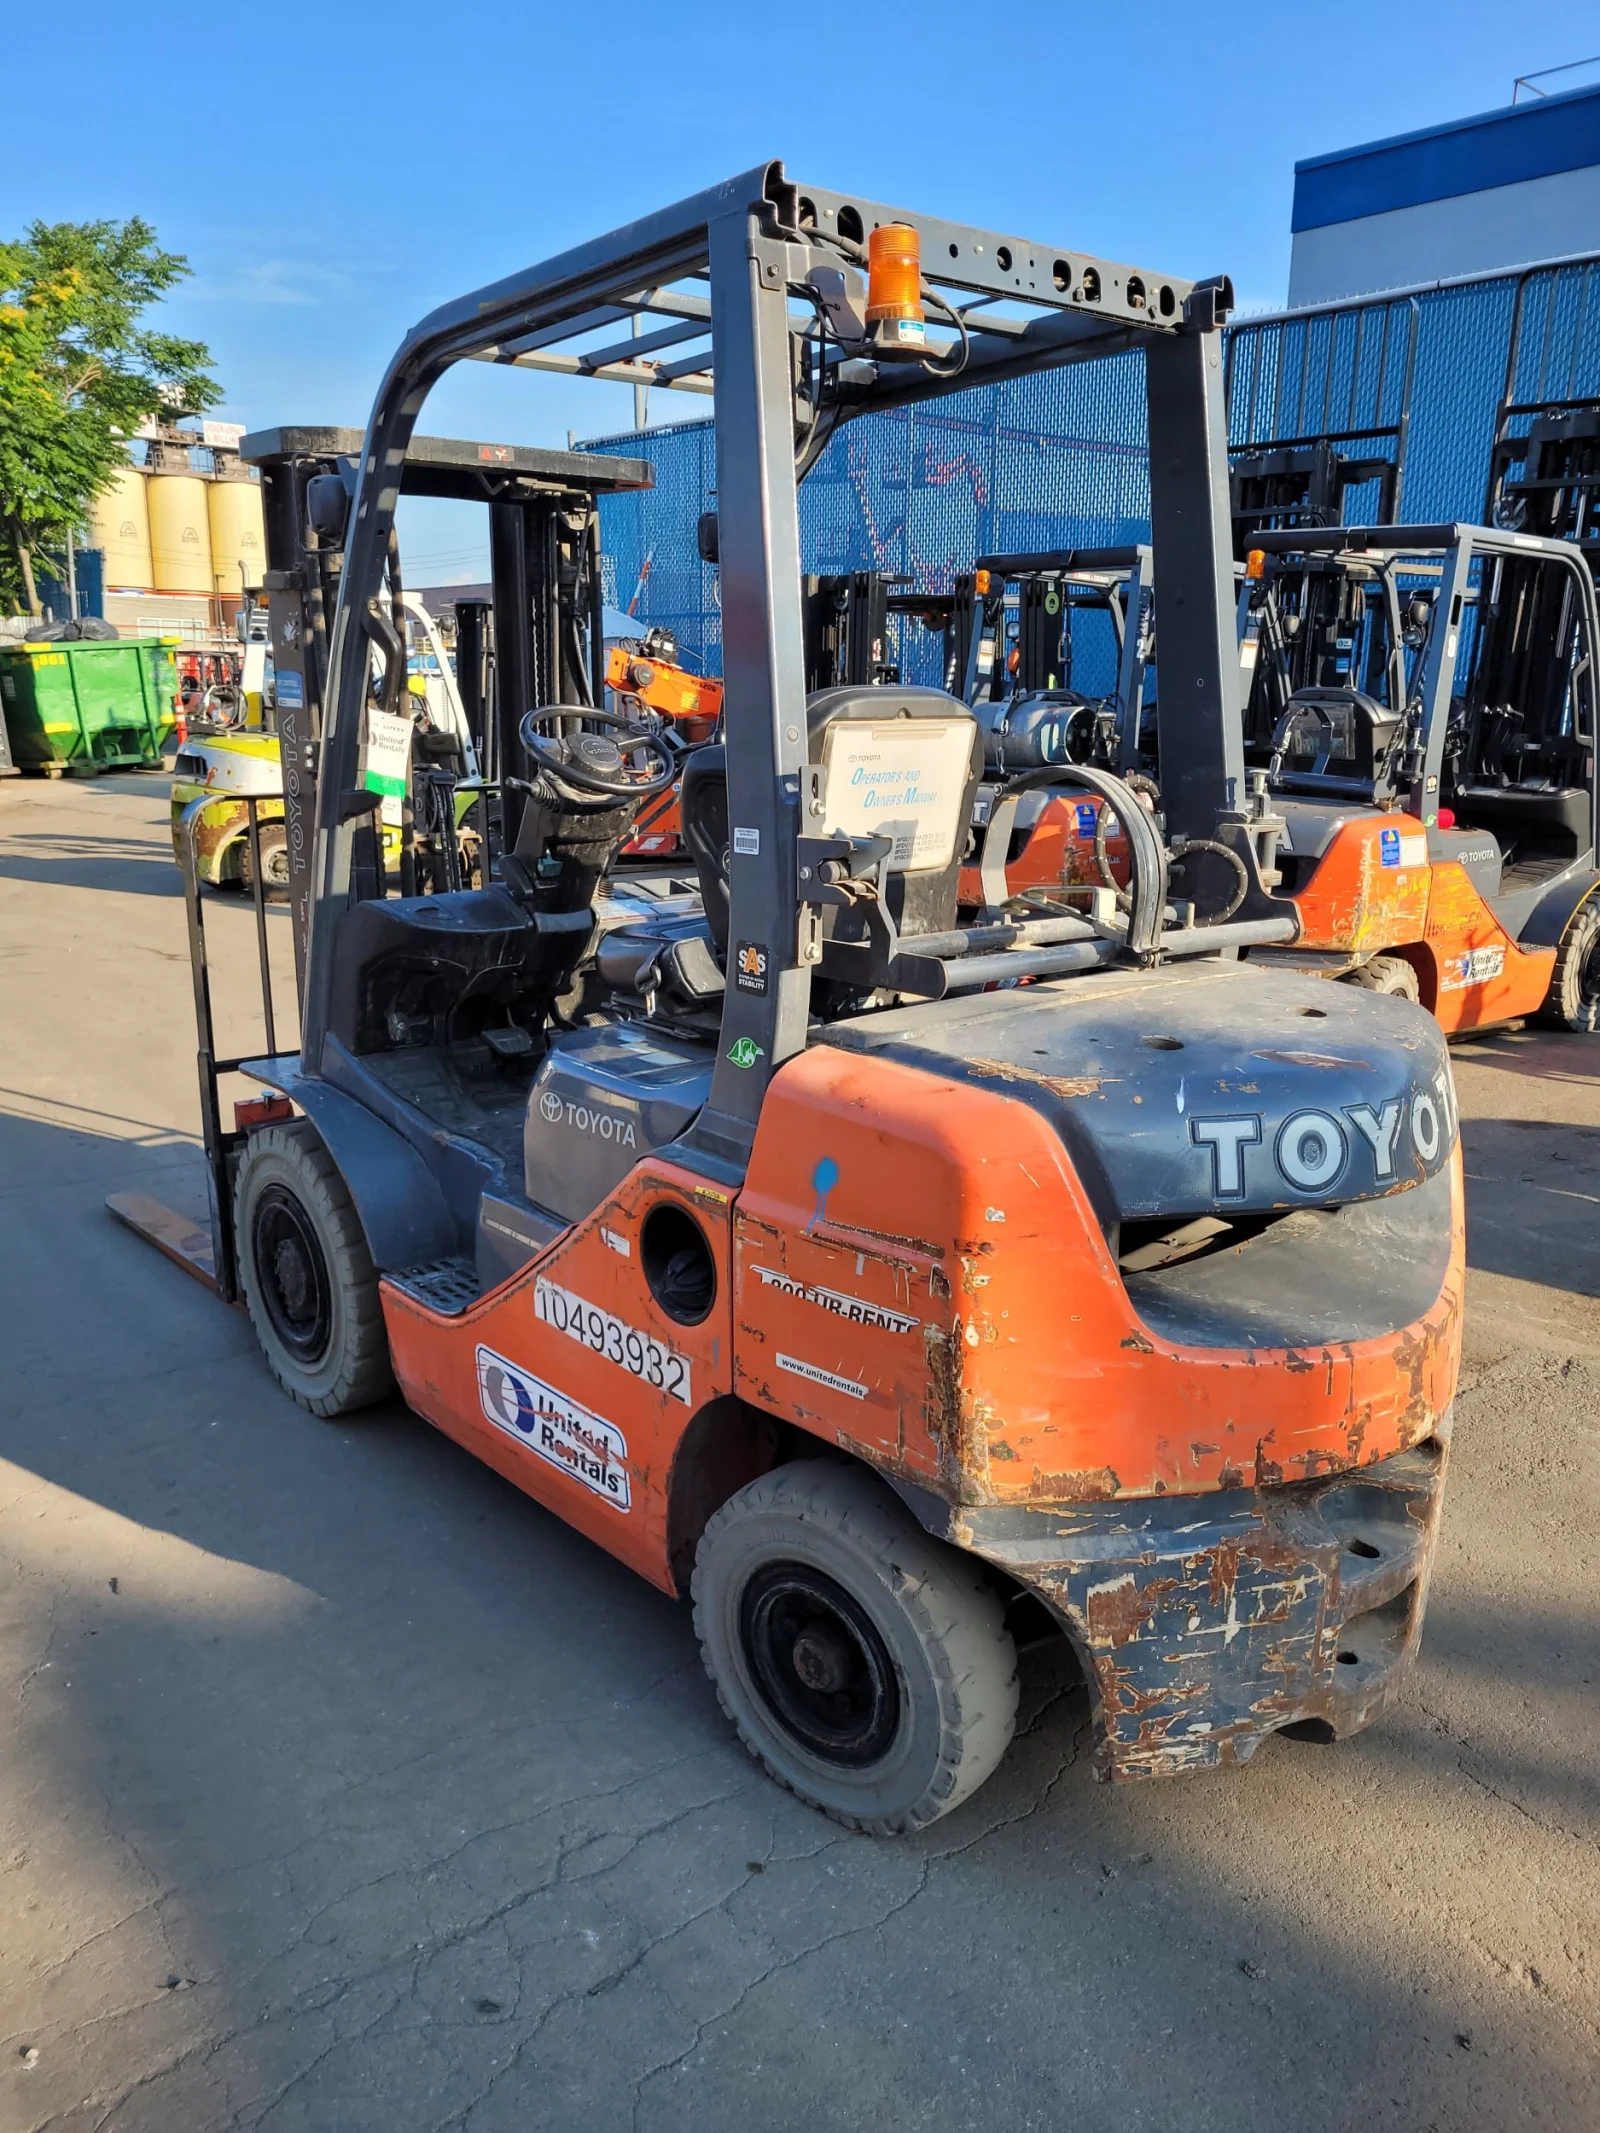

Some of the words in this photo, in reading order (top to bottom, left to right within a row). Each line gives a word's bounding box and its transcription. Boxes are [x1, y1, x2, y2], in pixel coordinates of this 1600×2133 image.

[378, 733, 405, 745] United
[378, 742, 405, 754] Rentals
[857, 754, 881, 762] TOYOTA
[850, 767, 903, 785] OPERATOR'S
[904, 770, 921, 782] AND
[282, 713, 306, 875] TOYOTA
[863, 790, 903, 808] OWNER'S
[902, 787, 938, 805] MANUAL
[1468, 849, 1495, 863] TOYOTA
[738, 946, 766, 976] SAS
[1471, 952, 1499, 968] United
[1468, 962, 1500, 979] Rentals
[738, 978, 765, 991] STABILITY
[565, 1102, 636, 1149] TOYOTA
[537, 1284, 686, 1403] 10493932
[538, 1394, 610, 1454] United
[541, 1423, 619, 1493] Rentals
